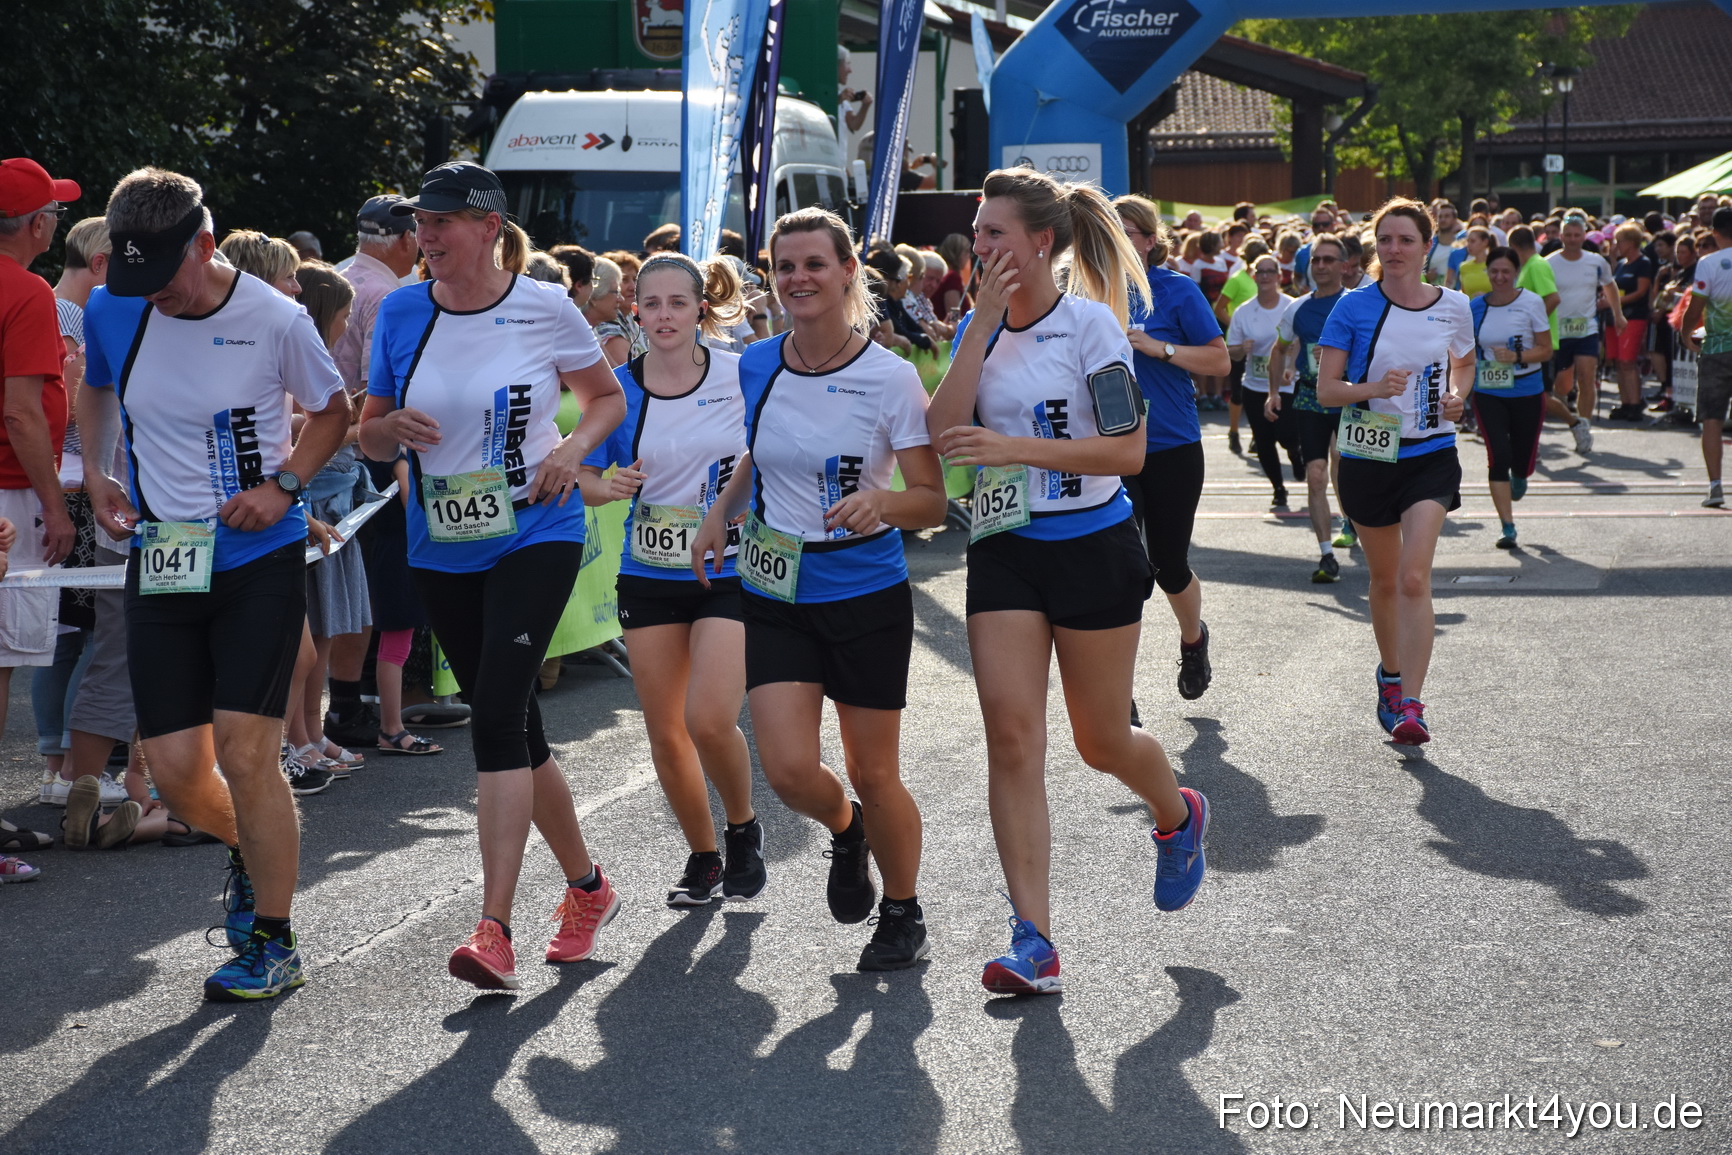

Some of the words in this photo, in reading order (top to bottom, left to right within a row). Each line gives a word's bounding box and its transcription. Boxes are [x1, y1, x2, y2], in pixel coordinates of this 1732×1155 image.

[1091, 9, 1179, 27] Fischer
[1097, 28, 1172, 37] AUTOMOBILE
[507, 133, 577, 149] abavent
[1481, 369, 1509, 381] 1055
[205, 430, 216, 460] WASTE
[492, 408, 506, 466] TECHNOL
[504, 384, 532, 488] HUBER
[1345, 423, 1391, 448] 1038
[208, 462, 219, 489] WATER
[484, 485, 502, 494] 2019
[433, 494, 500, 524] 1043
[975, 484, 1018, 521] 1052
[1002, 509, 1022, 518] Marina
[464, 521, 490, 529] Sascha
[636, 523, 687, 551] 1061
[143, 547, 197, 574] 1041
[641, 547, 658, 556] Walter
[658, 550, 681, 558] Natalie
[744, 538, 787, 581] 1060
[755, 570, 776, 585] Melanie
